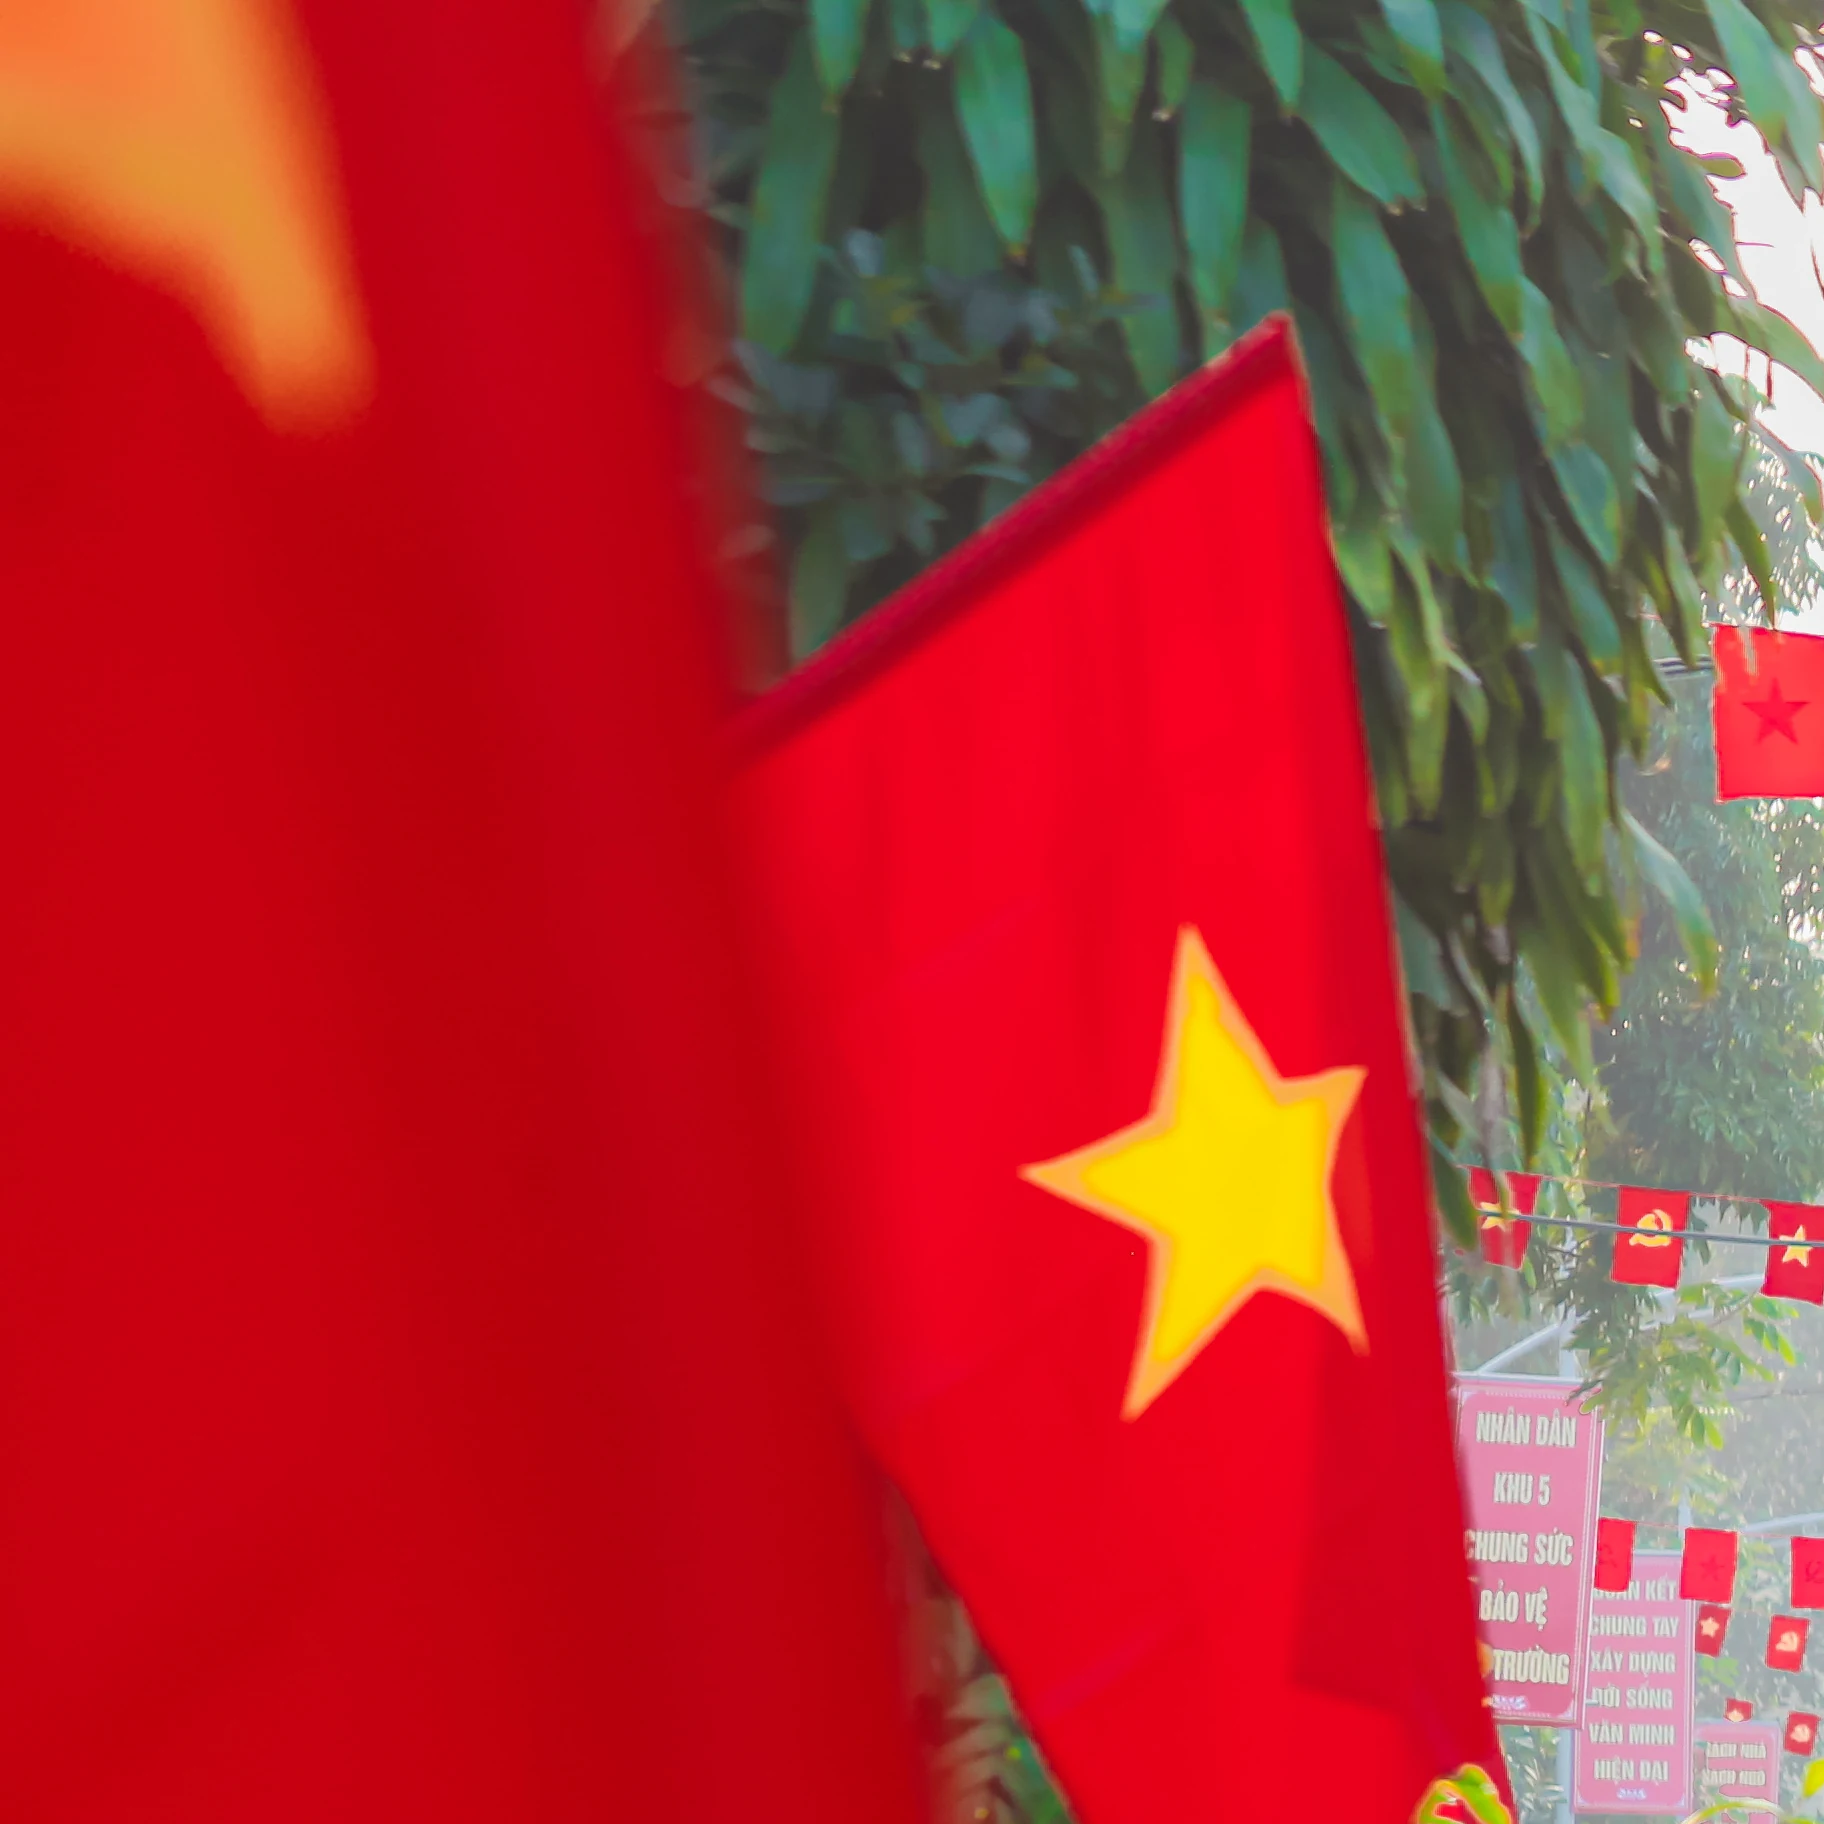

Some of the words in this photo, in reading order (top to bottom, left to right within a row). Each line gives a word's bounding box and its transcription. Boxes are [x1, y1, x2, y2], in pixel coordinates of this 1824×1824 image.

[1476, 1406, 1531, 1444] NHÂN
[1536, 1408, 1576, 1447] DÂN
[1494, 1472, 1533, 1504] KHU
[1538, 1475, 1550, 1506] 5
[1534, 1527, 1574, 1566] SỨC
[1479, 1579, 1519, 1622] BẢO
[1525, 1586, 1548, 1631] VỆ
[1652, 1616, 1679, 1637] TAY
[1493, 1644, 1571, 1684] TRƯỜNG
[1591, 1646, 1623, 1672] XÂY
[1629, 1723, 1674, 1745] MINH
